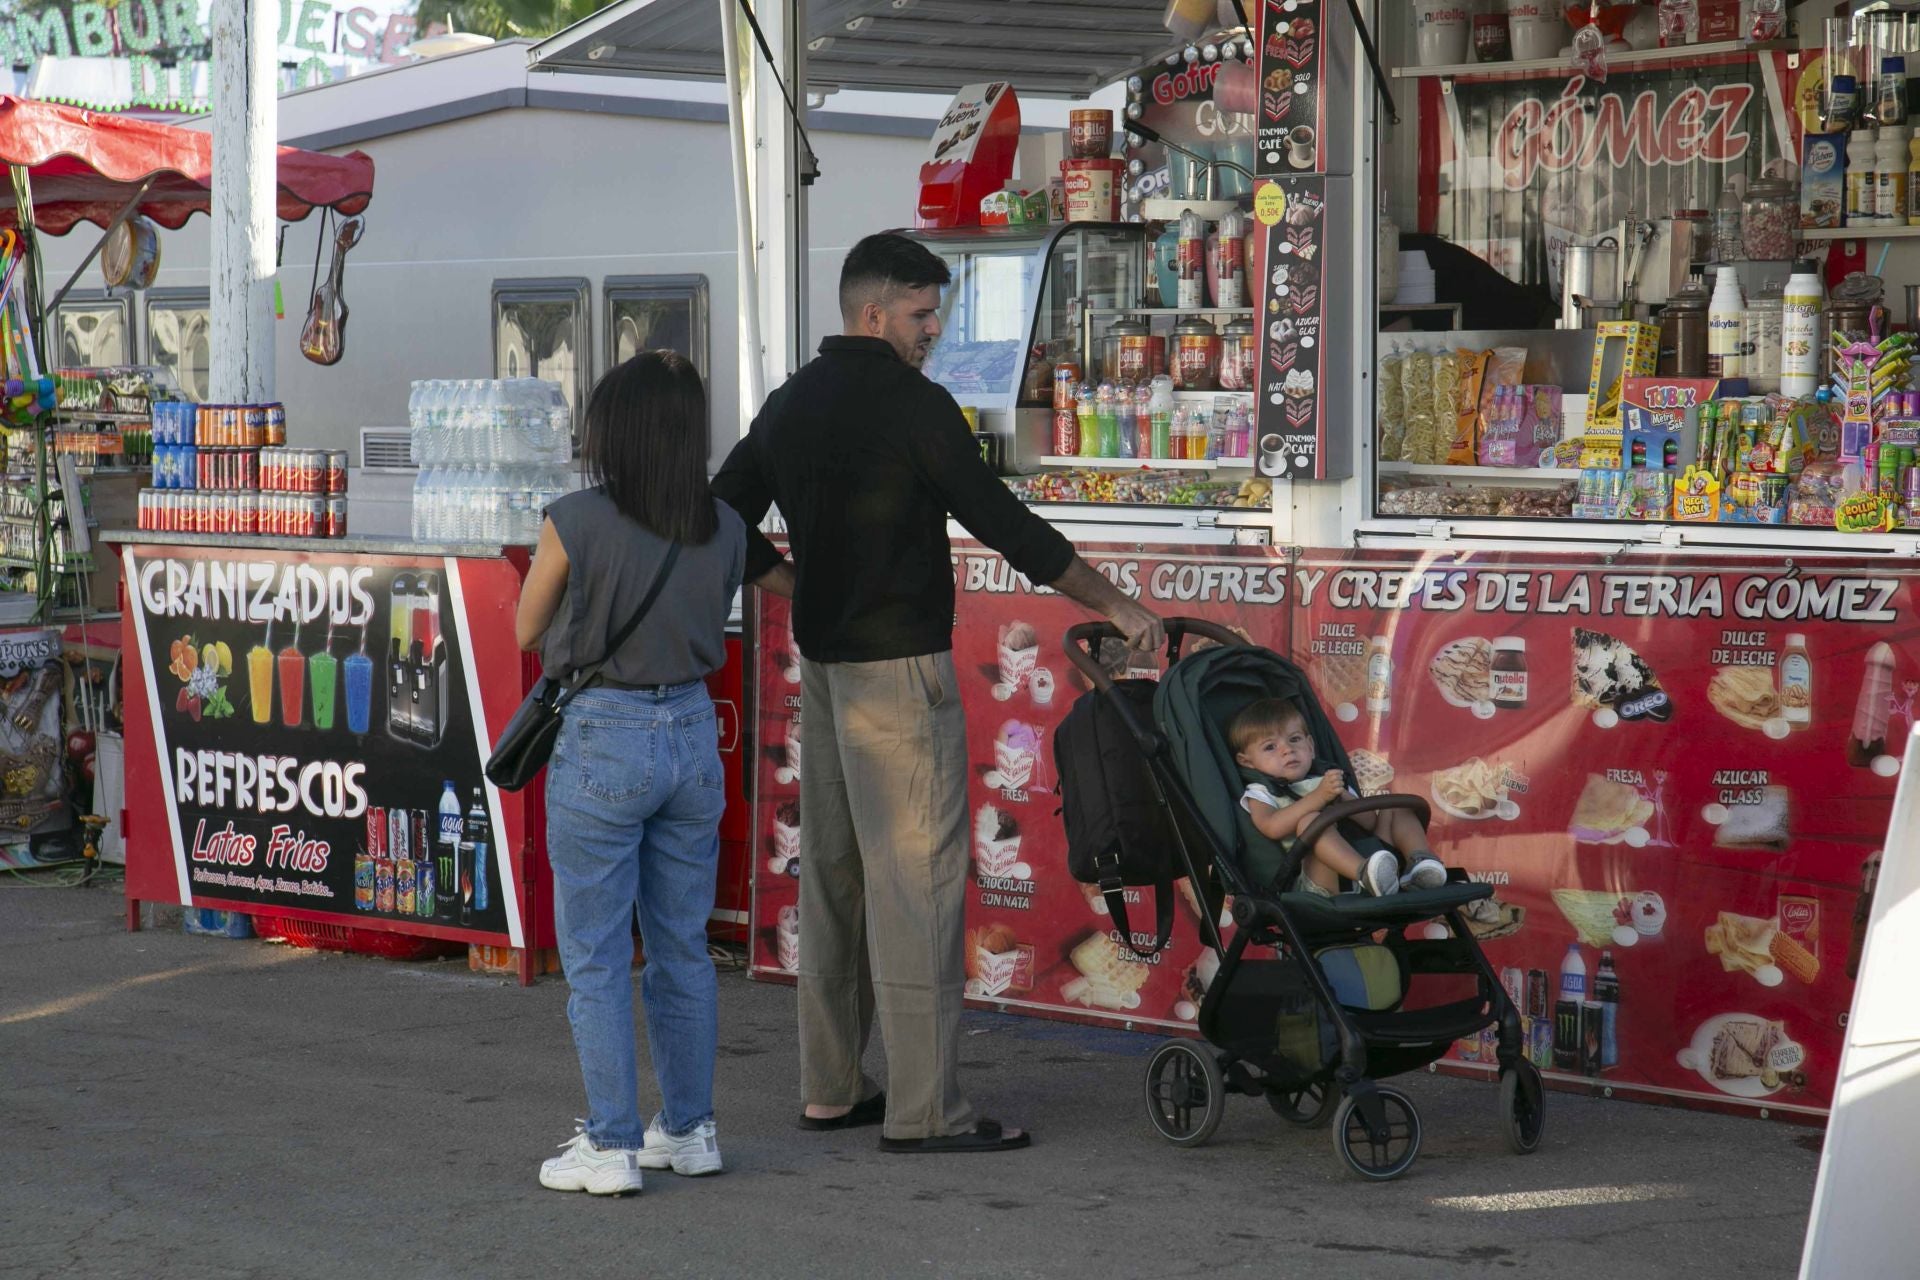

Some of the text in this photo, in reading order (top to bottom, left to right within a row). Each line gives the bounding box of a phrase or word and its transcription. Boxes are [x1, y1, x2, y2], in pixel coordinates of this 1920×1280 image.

[1425, 8, 1465, 22] nutella
[1294, 72, 1311, 82] SOLO
[938, 108, 980, 129] bueno
[1258, 127, 1289, 137] TENEMOS
[1495, 74, 1755, 191] GÓMEZ
[1258, 137, 1282, 150] CAFÉ
[1295, 317, 1320, 326] AZUCAR
[1299, 326, 1317, 336] GLAS
[1285, 434, 1316, 443] TENEMOS
[1291, 442, 1315, 455] CAFÉ
[1684, 503, 1705, 515] ROLL
[1848, 511, 1879, 529] MIC
[140, 558, 375, 625] GRANIZADOS
[1151, 563, 1287, 604] GOFRES
[1295, 569, 1325, 607] Y
[1328, 571, 1468, 610] CREPES
[1474, 572, 1532, 612] DE
[1536, 573, 1592, 614] LA
[1601, 574, 1724, 619] FERIA
[1733, 567, 1899, 622] GÓMEZ
[1319, 623, 1356, 637] DULCE
[1721, 630, 1766, 646] DULCE
[1311, 640, 1363, 655] DE LECHE
[1711, 649, 1776, 666] DE LECHE
[1494, 673, 1525, 684] nutella
[1620, 691, 1668, 717] OREO
[176, 747, 369, 818] REFRESCOS
[1606, 768, 1643, 784] FRESA
[1712, 770, 1768, 785] AZUCAR
[1501, 778, 1528, 793] BUENO
[1001, 789, 1029, 803] FRESA
[1719, 789, 1764, 804] GLASS
[192, 818, 257, 867] Latas
[976, 876, 1035, 894] CHOCOLATE
[1477, 871, 1509, 885] NATA
[980, 892, 1030, 909] CON NATA
[1122, 890, 1140, 903] ATA
[1110, 929, 1172, 949] CHCOLAE
[1562, 975, 1583, 991] AGUA
[1771, 1046, 1799, 1058] FERRERO
[1772, 1055, 1800, 1067] ROCHER
